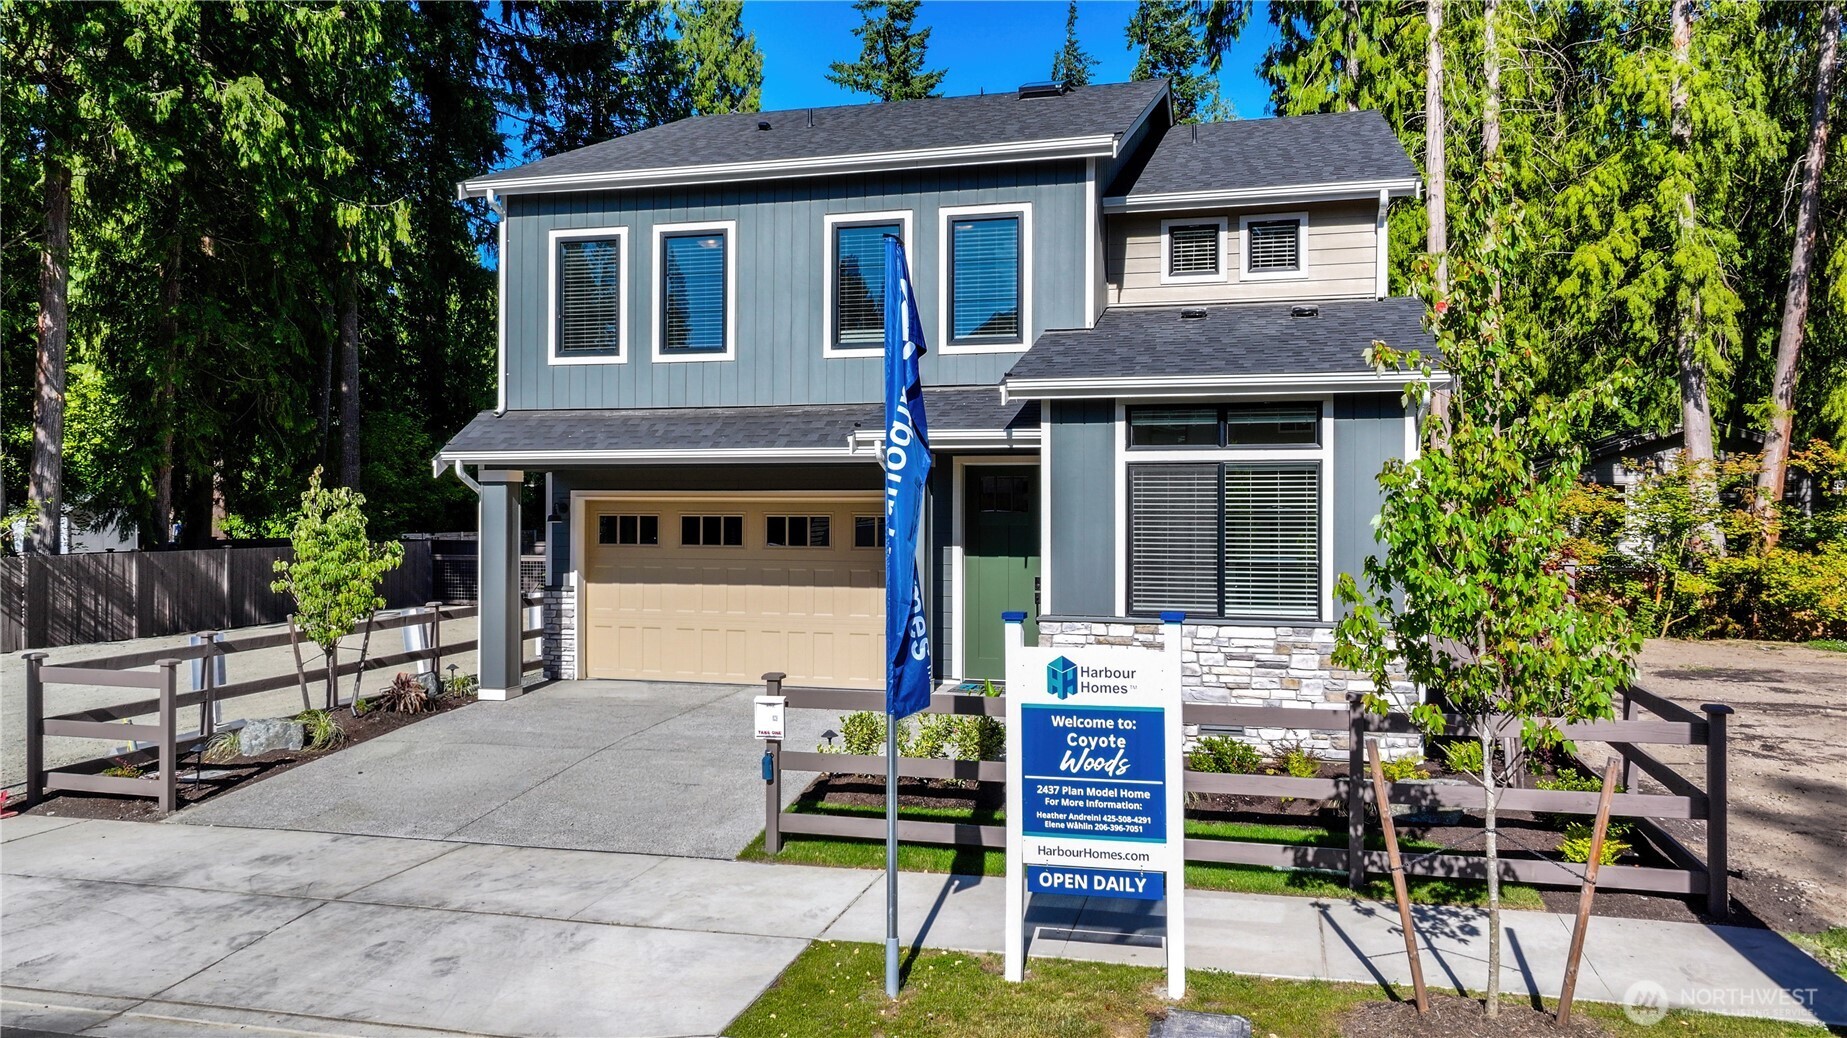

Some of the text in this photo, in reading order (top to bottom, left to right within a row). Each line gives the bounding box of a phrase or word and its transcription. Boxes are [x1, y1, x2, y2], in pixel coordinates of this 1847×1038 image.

[1080, 666, 1136, 679] Harbour
[1080, 681, 1128, 694] Homes
[1051, 715, 1137, 730] Welcome to:
[1066, 732, 1127, 750] Coyote
[1059, 747, 1131, 777] Woods
[1036, 785, 1151, 799] 2437 Plan Model Home
[1044, 797, 1143, 810] For More Information:
[1036, 811, 1067, 820] Heather
[1103, 814, 1151, 824] 425-508-4291
[1044, 821, 1065, 829] Elene
[1094, 823, 1143, 833] 206-396-7051
[1037, 845, 1150, 862] HarbourHomes.com
[1039, 872, 1147, 893] OPEN DAILY
